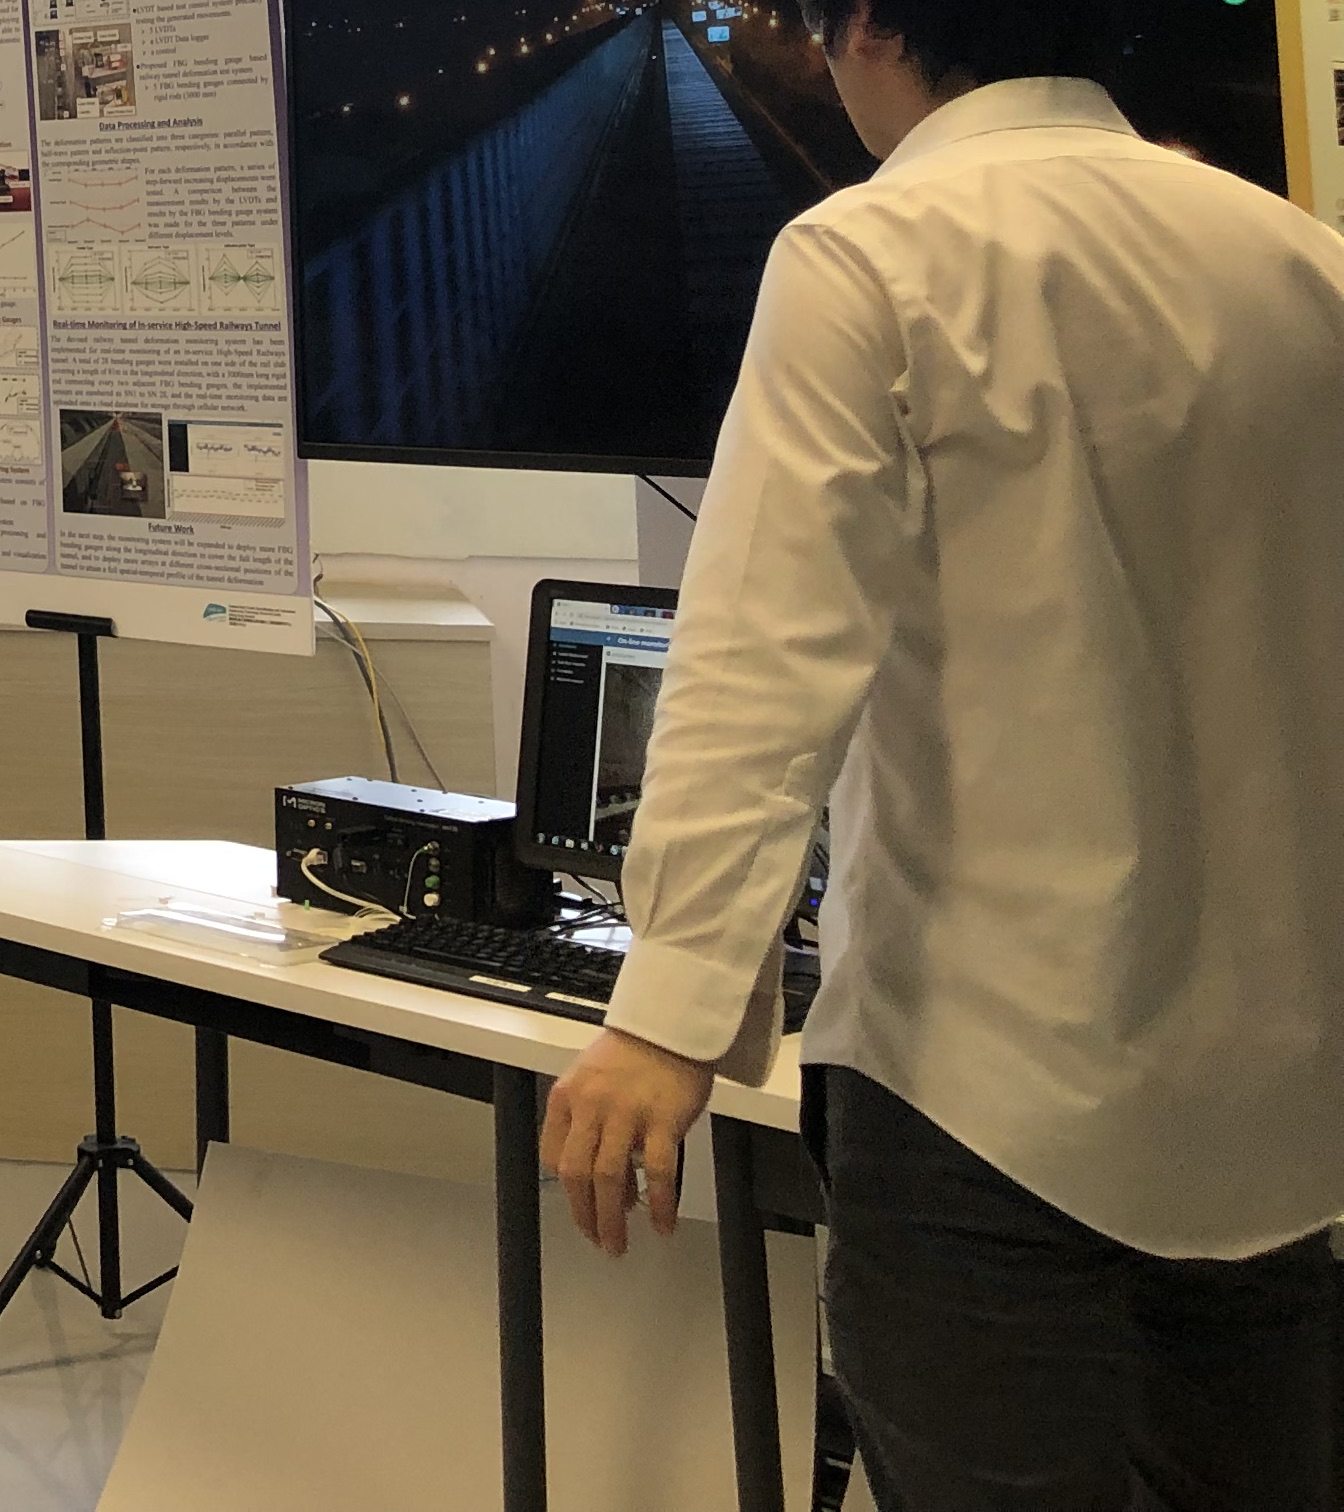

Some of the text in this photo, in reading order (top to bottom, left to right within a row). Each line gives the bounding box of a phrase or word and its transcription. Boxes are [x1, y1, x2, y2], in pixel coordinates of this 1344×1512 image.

[99, 117, 203, 131] Data Processing and Analysis
[53, 320, 281, 331] Real-time Monitoring of In-service High-Speed Railways Tunnel
[148, 522, 194, 535] Future Work
